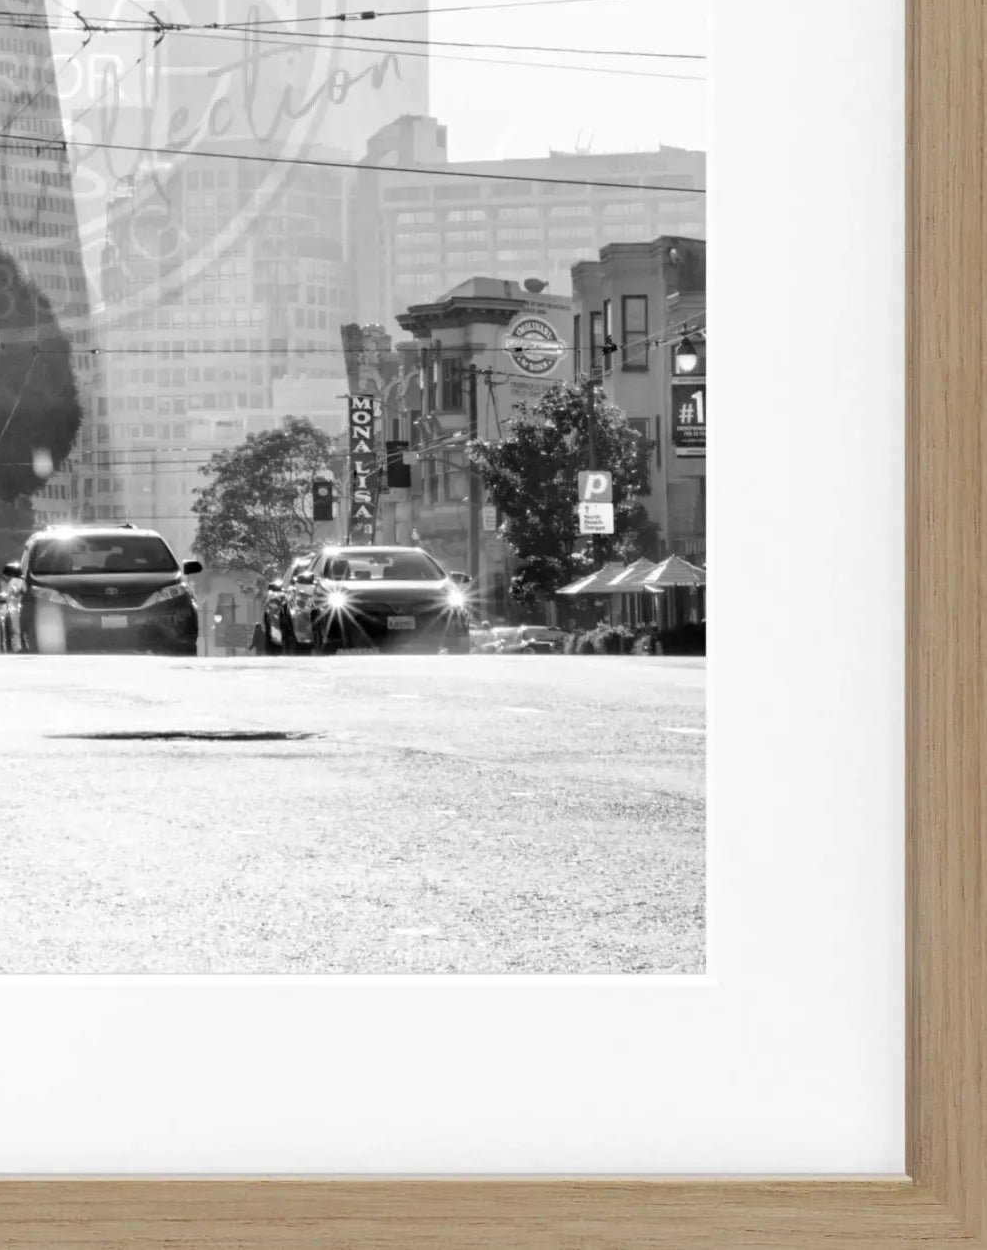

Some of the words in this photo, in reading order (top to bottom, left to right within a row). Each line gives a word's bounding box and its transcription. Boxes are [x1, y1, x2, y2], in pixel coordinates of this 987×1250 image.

[351, 398, 372, 453] MONA
[679, 390, 705, 424] #1
[353, 461, 373, 518] LISA
